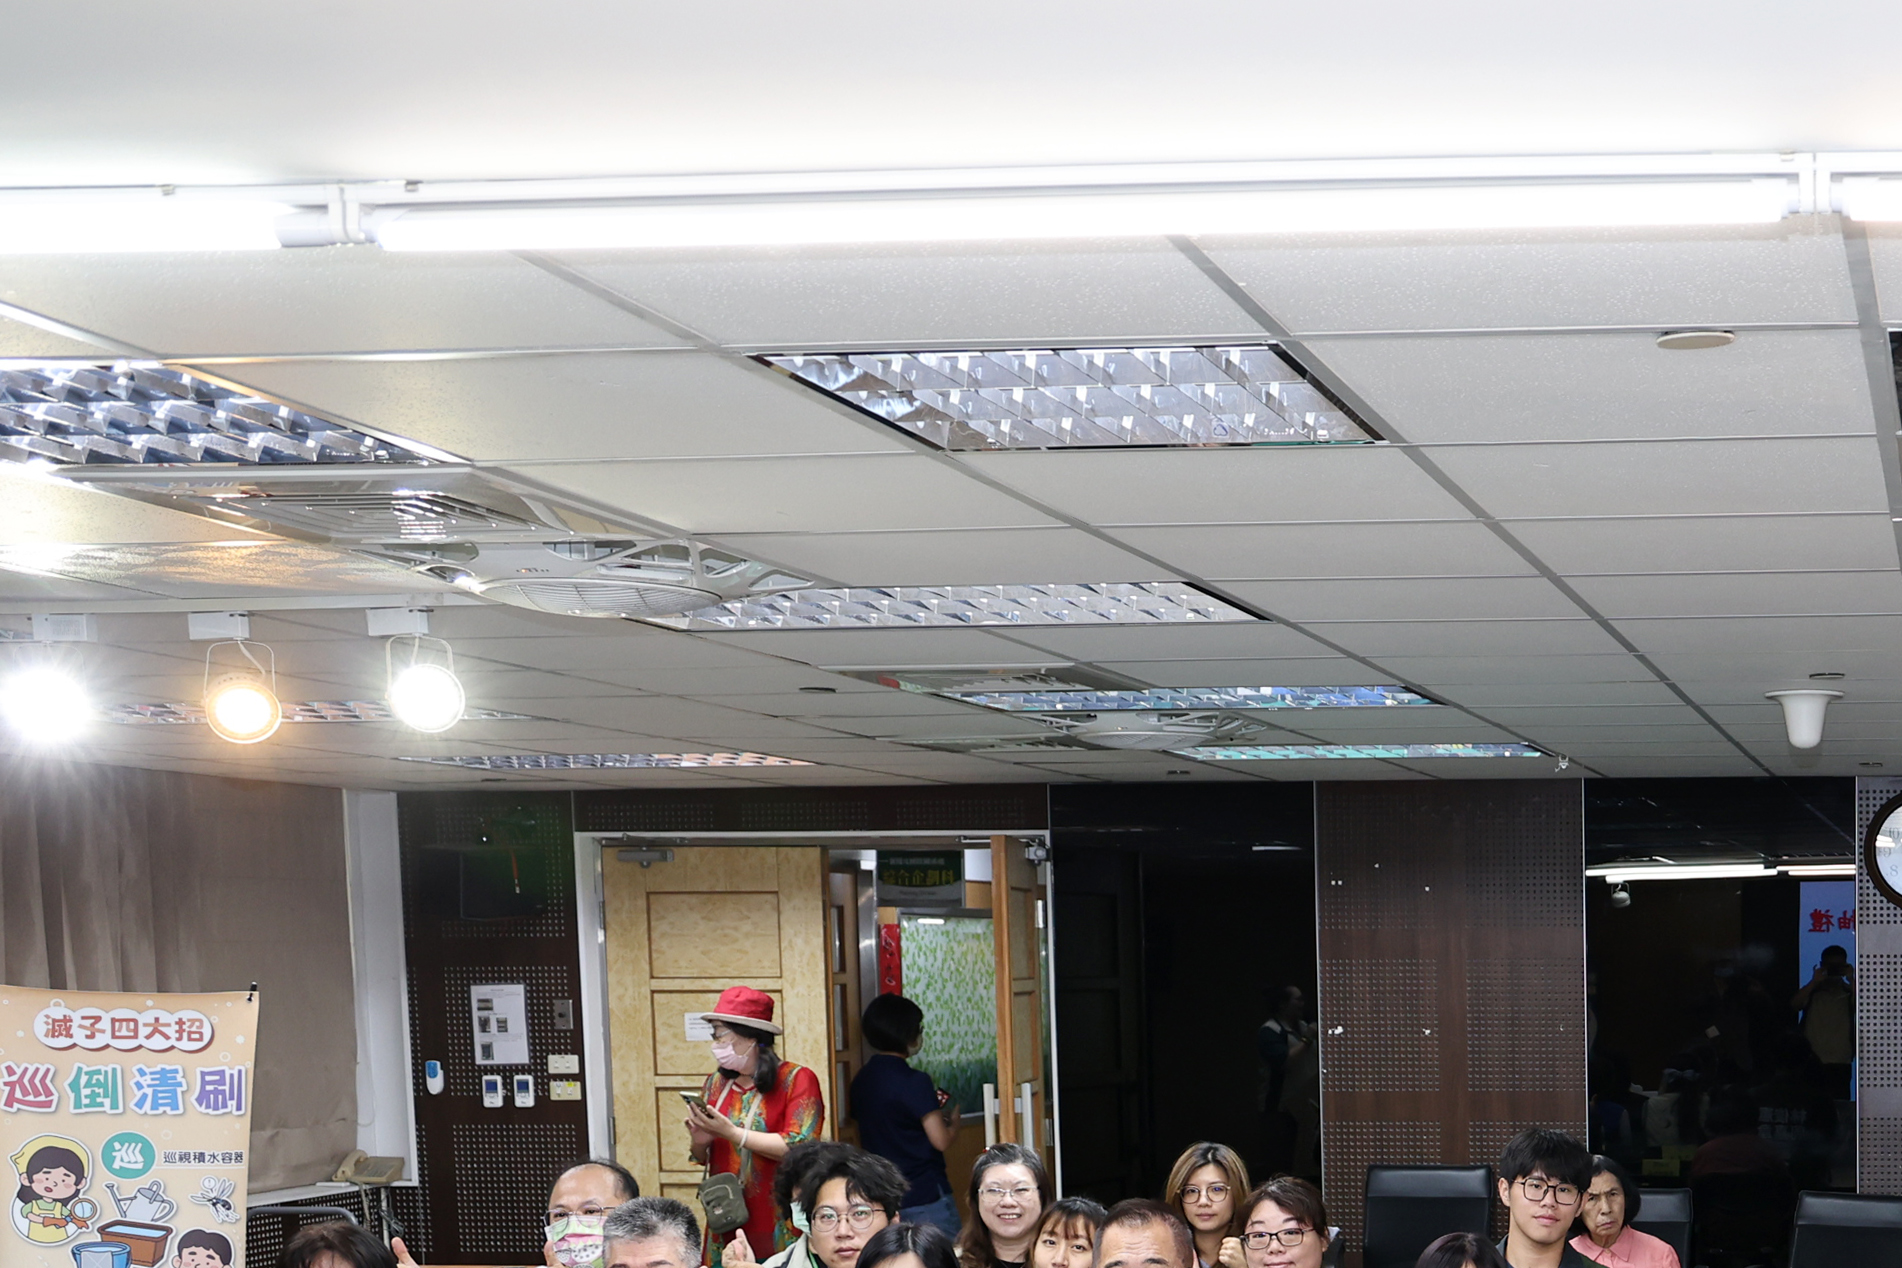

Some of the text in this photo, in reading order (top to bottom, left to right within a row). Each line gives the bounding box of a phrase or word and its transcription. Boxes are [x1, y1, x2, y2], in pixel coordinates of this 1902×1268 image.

[1890, 864, 1899, 877] 8
[1, 1064, 246, 1112] 巡倒清刷
[112, 1140, 146, 1170] 巡
[163, 1151, 244, 1165] 巡視積水容器
